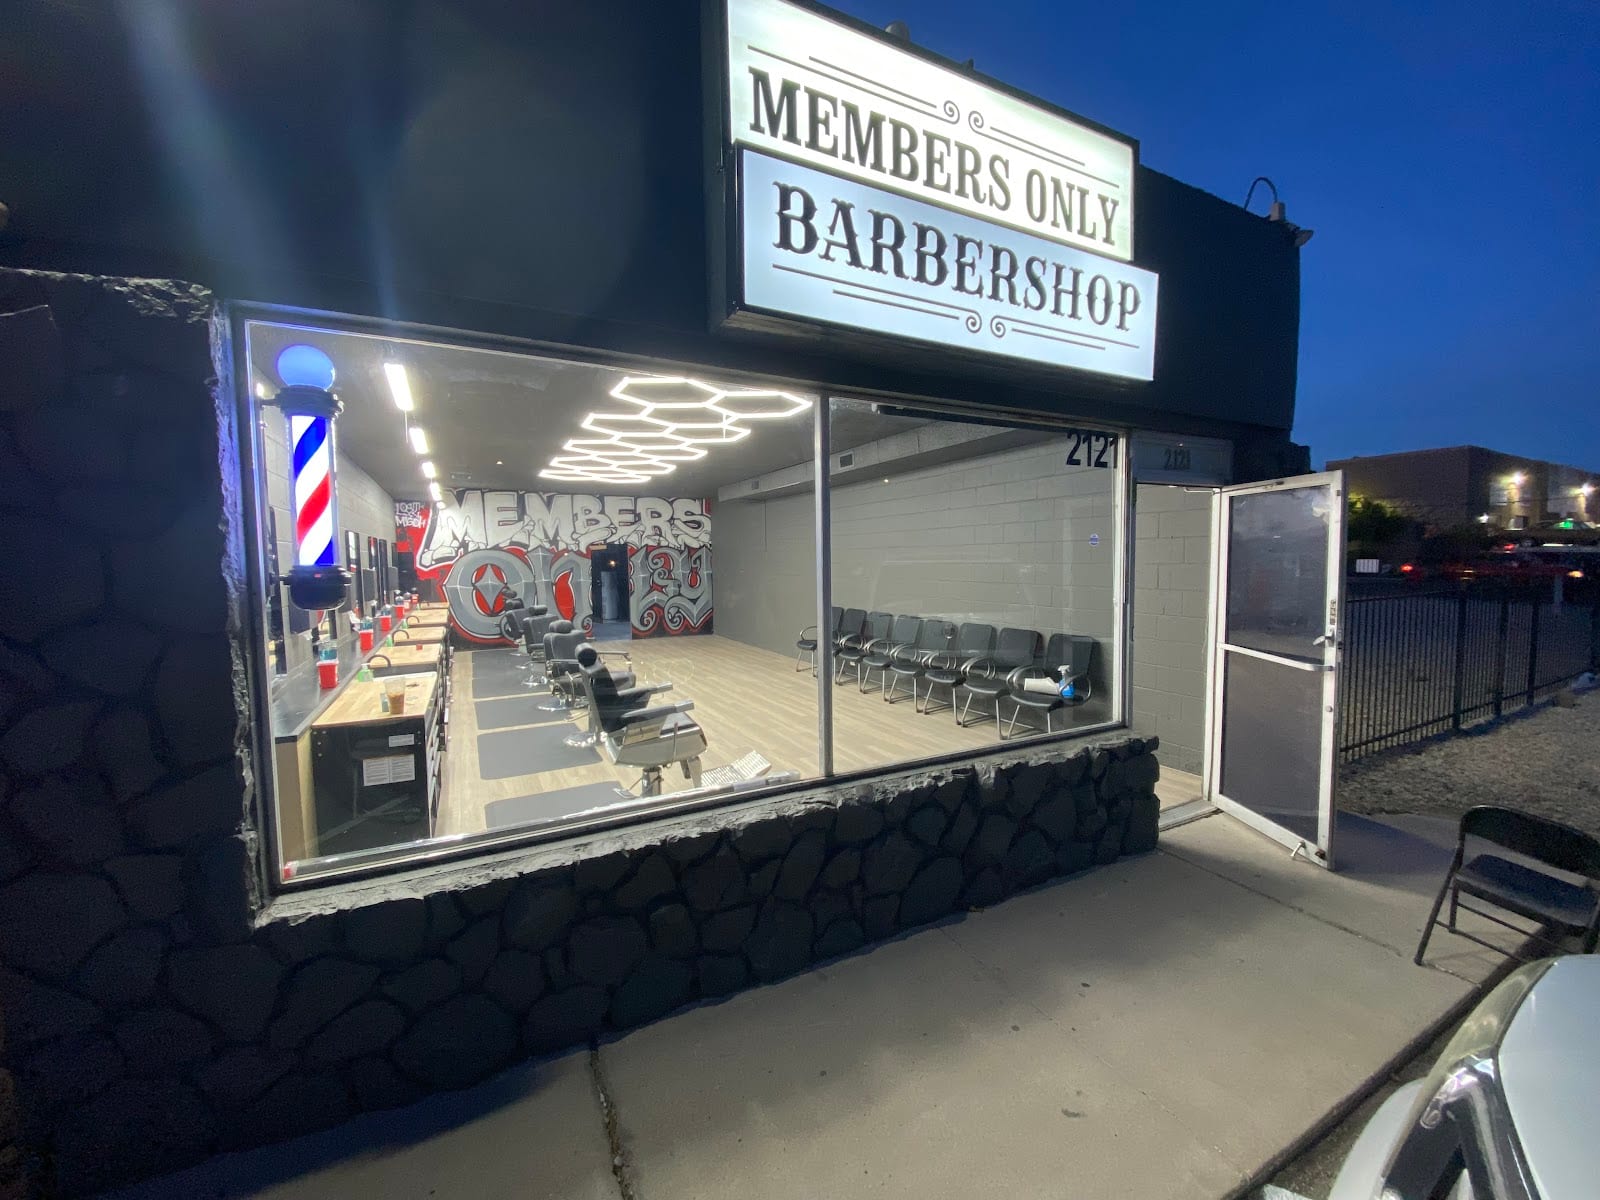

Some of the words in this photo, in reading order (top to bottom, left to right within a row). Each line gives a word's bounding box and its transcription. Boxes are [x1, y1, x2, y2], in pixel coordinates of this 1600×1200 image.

[748, 65, 1012, 212] MEMBERS
[1025, 168, 1120, 247] ONLY
[772, 181, 1142, 332] BARBERSHOP
[1066, 431, 1118, 469] 2121
[1163, 448, 1192, 471] 2121
[419, 488, 713, 566] MEMBERS
